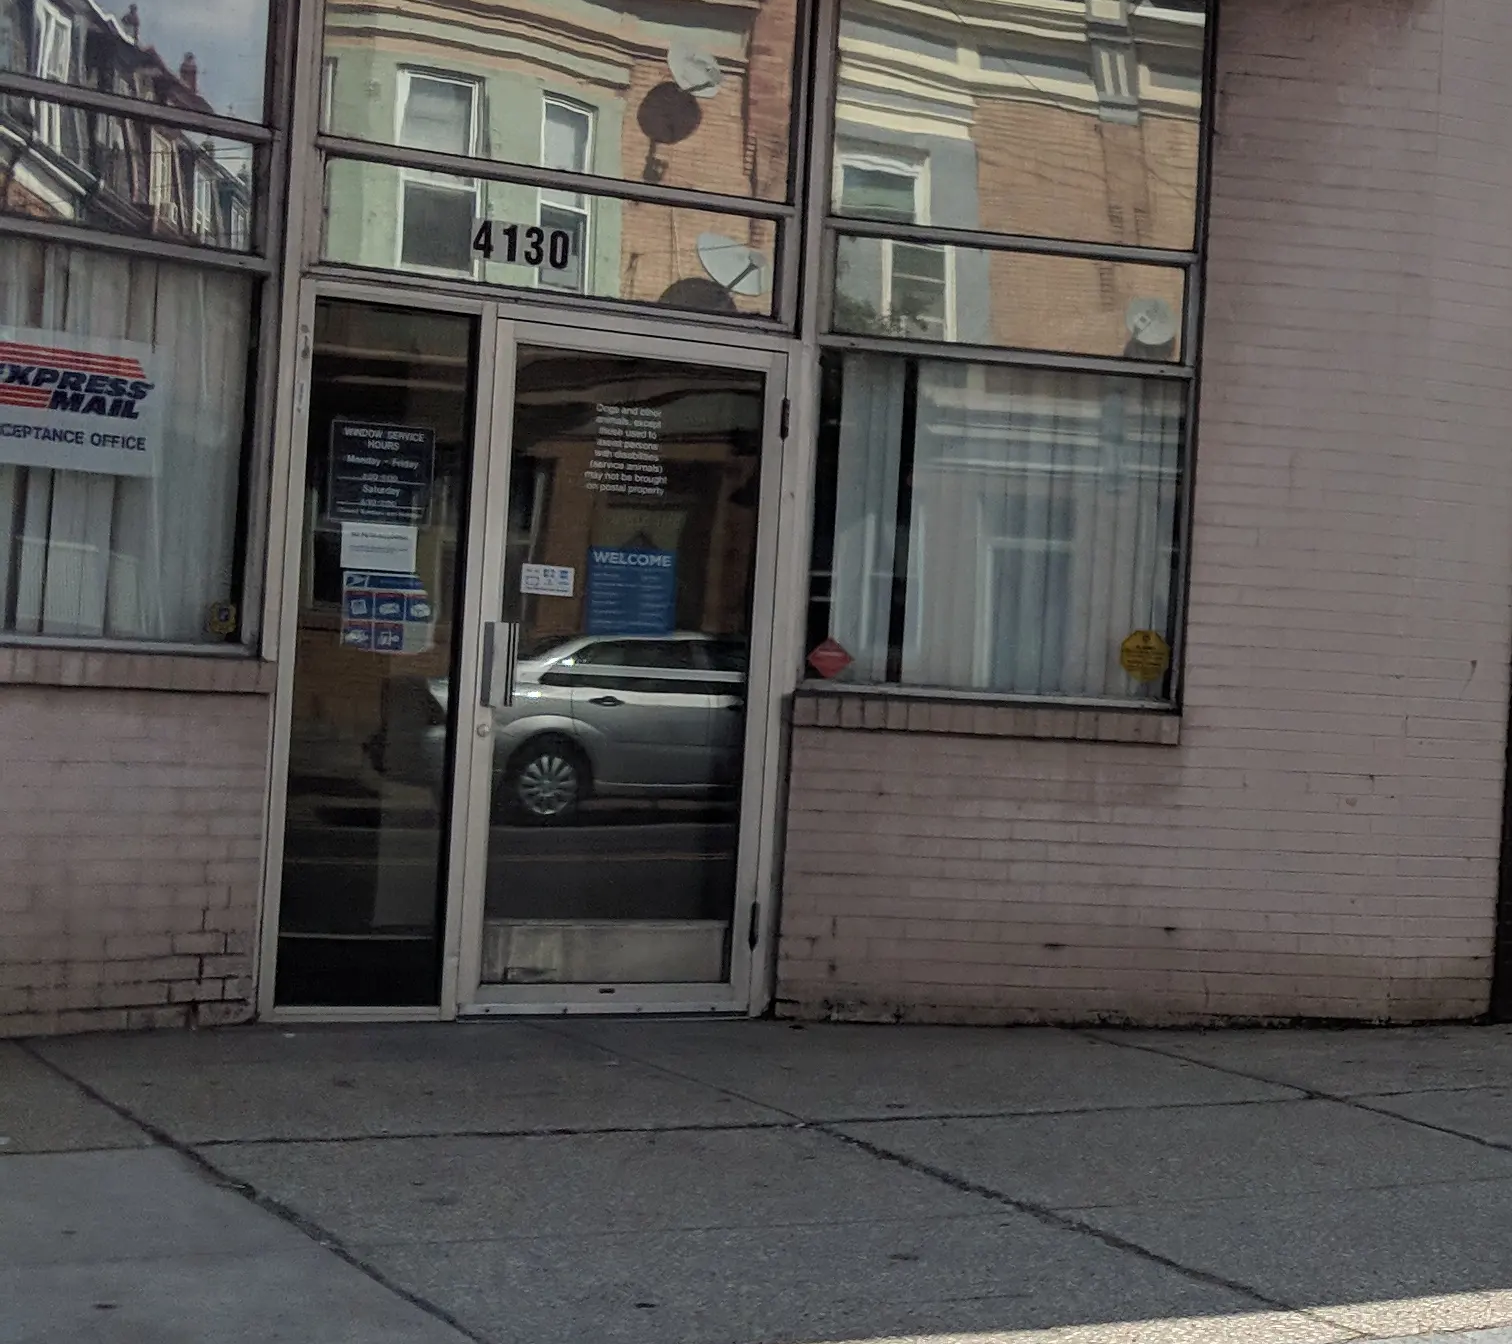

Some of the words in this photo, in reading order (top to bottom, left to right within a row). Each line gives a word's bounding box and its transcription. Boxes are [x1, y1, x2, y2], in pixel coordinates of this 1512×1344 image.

[473, 220, 570, 269] 4130
[49, 390, 140, 420] MAIL
[596, 403, 620, 415] Dogs
[621, 406, 639, 416] and
[0, 423, 84, 445] CEPTANCE
[91, 432, 146, 452] OFFICE
[343, 427, 383, 438] WINDOW
[387, 430, 425, 443] SERVICE
[367, 439, 401, 452] HOURS
[604, 472, 620, 481] not
[600, 483, 626, 493] postal
[627, 485, 665, 497] property
[593, 549, 672, 568] WELCOME
